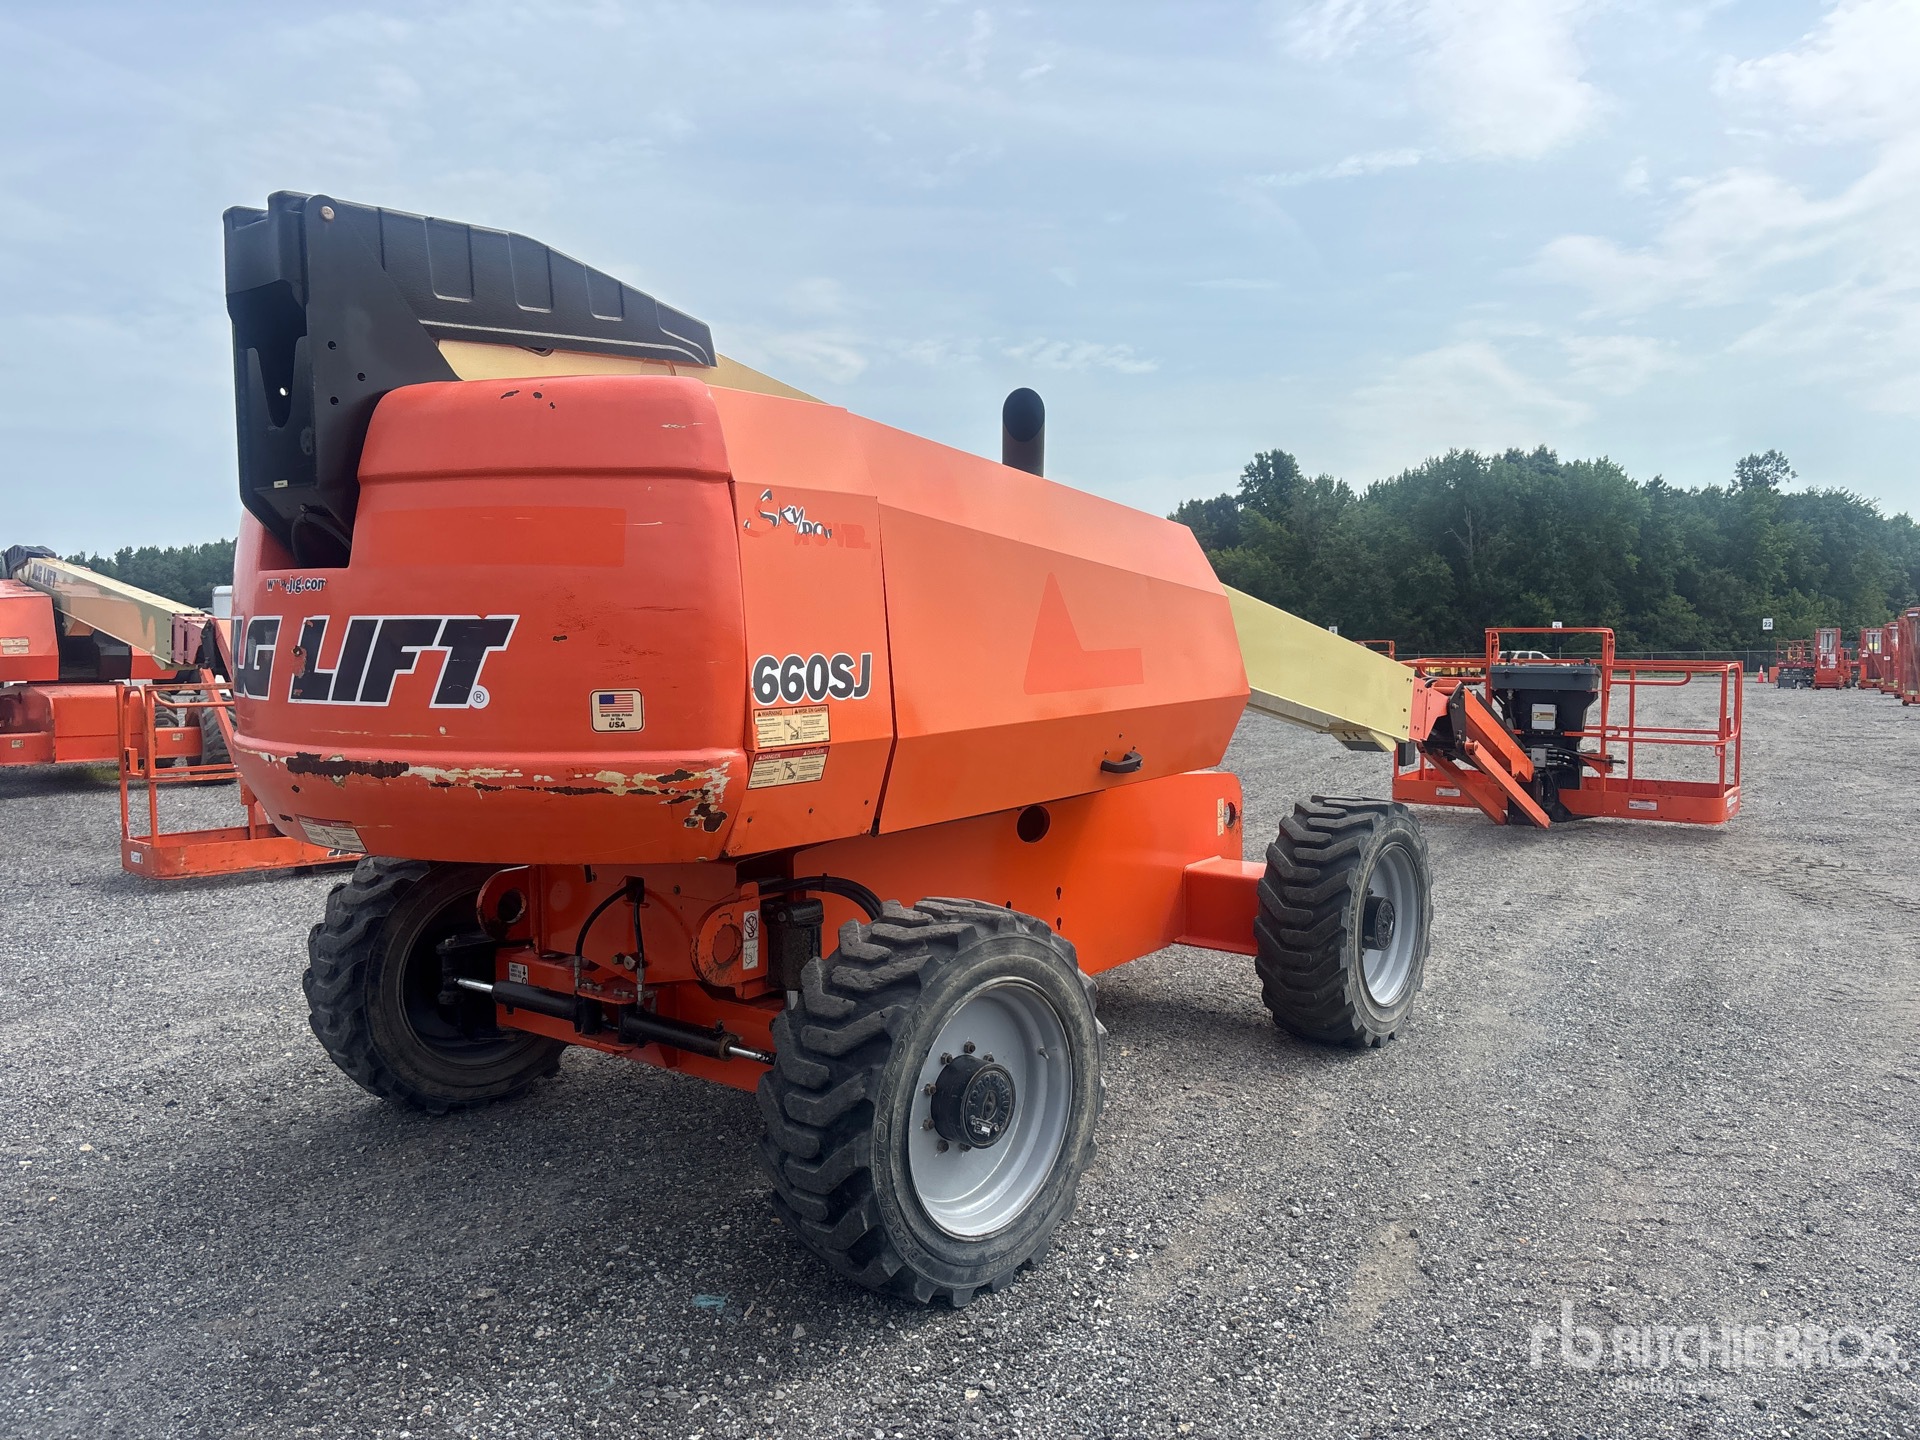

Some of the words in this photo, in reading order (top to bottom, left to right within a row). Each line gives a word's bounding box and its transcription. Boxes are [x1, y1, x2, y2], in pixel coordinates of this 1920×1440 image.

[42, 567, 56, 588] LIFT
[232, 615, 283, 701] LG
[752, 652, 872, 706] 660SJ
